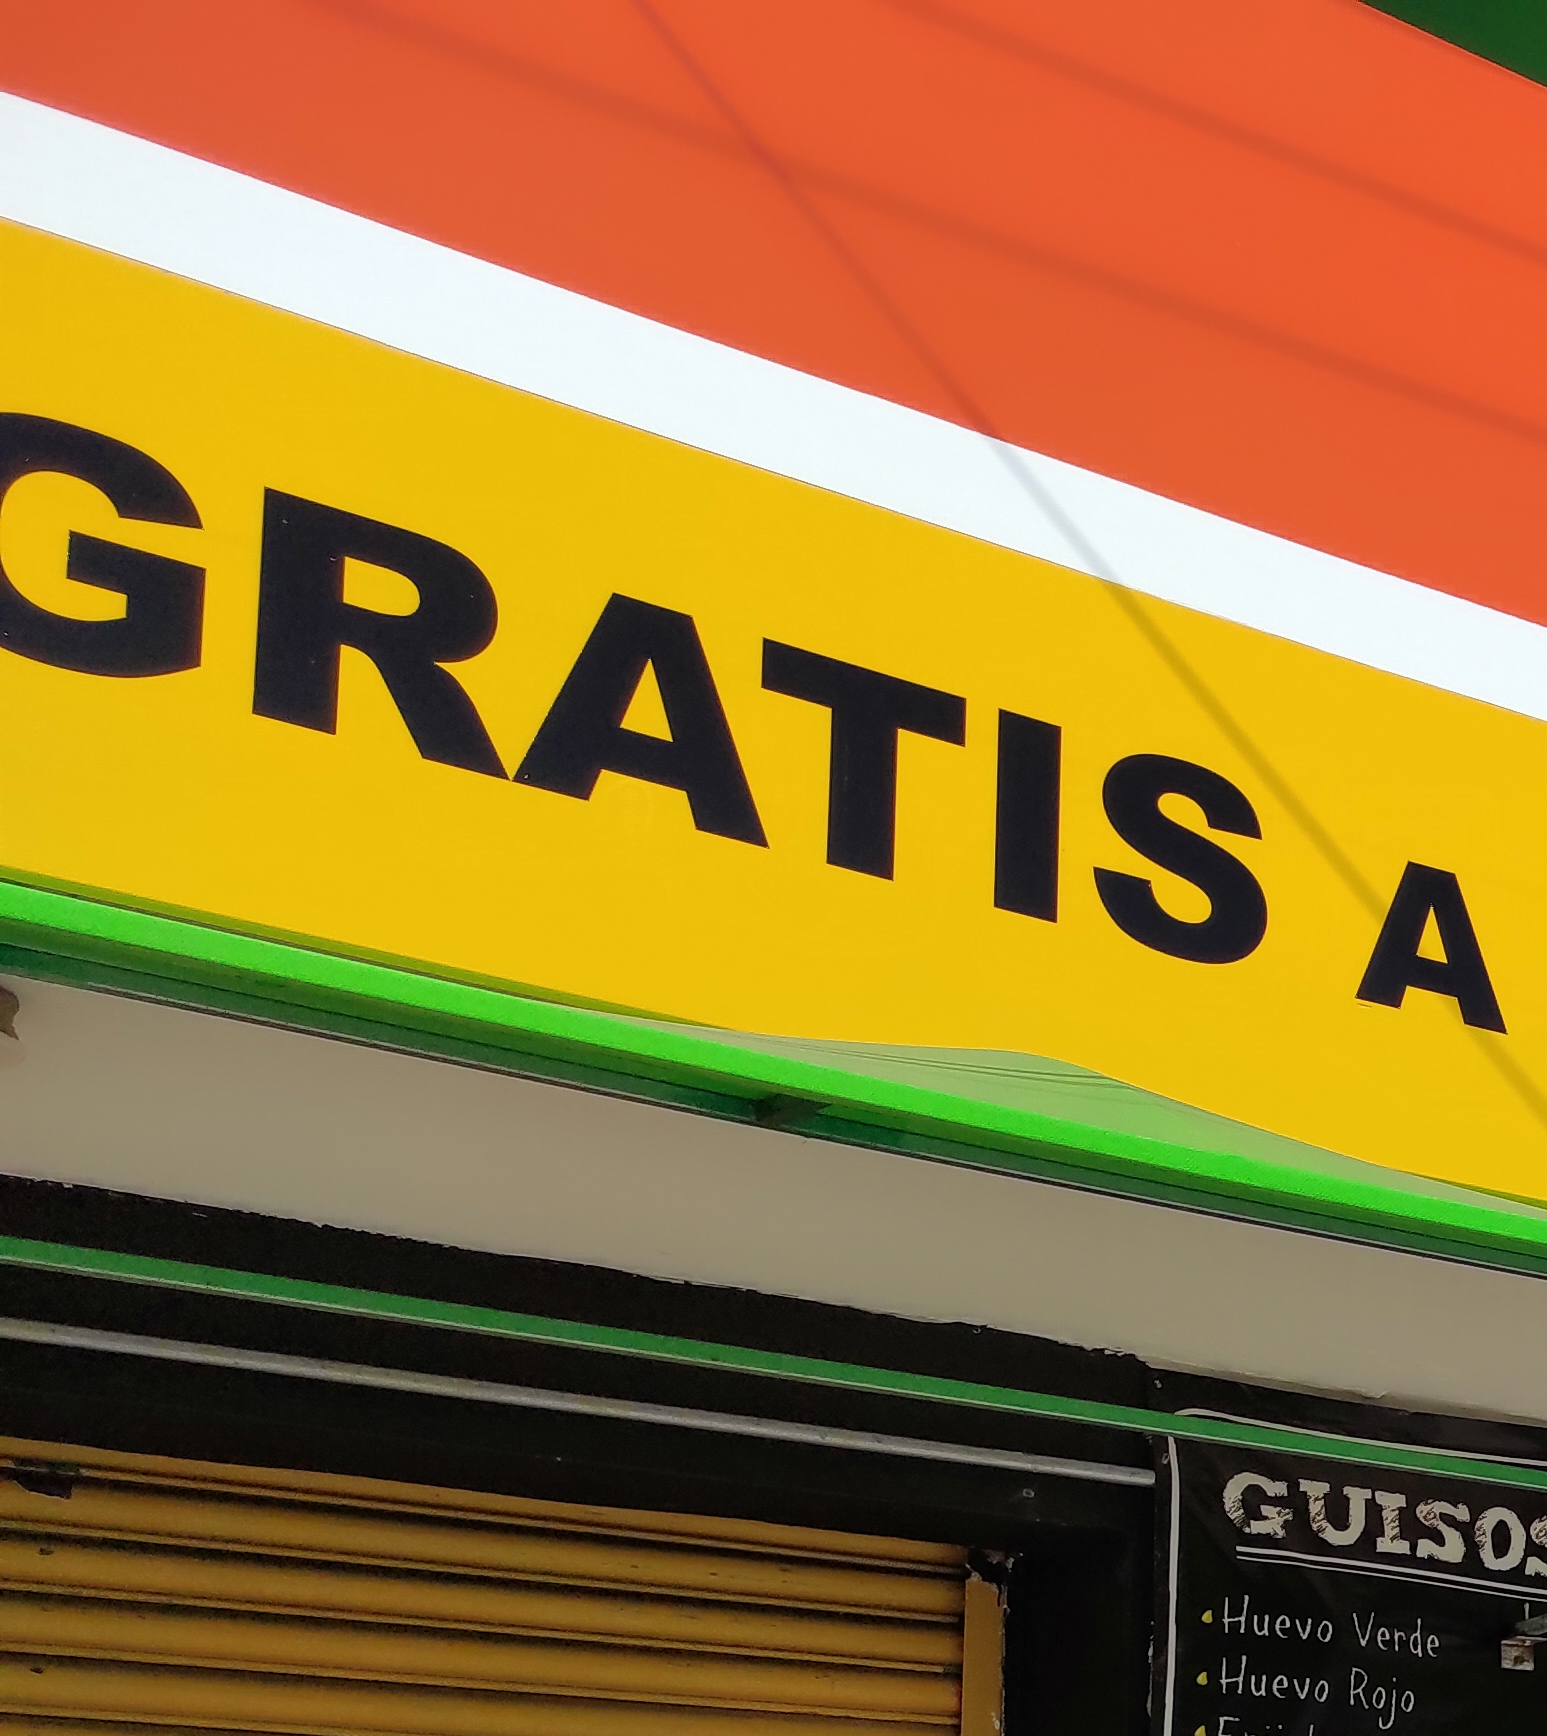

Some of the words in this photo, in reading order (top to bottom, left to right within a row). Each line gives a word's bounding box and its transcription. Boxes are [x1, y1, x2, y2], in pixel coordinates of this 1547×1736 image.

[0, 412, 1269, 966] GRATIS
[1355, 860, 1508, 1035] A
[1222, 1594, 1334, 1644] Huevo
[1354, 1611, 1441, 1659] Verde
[1219, 1654, 1329, 1704] Huevo
[1349, 1666, 1415, 1730] Rojo
